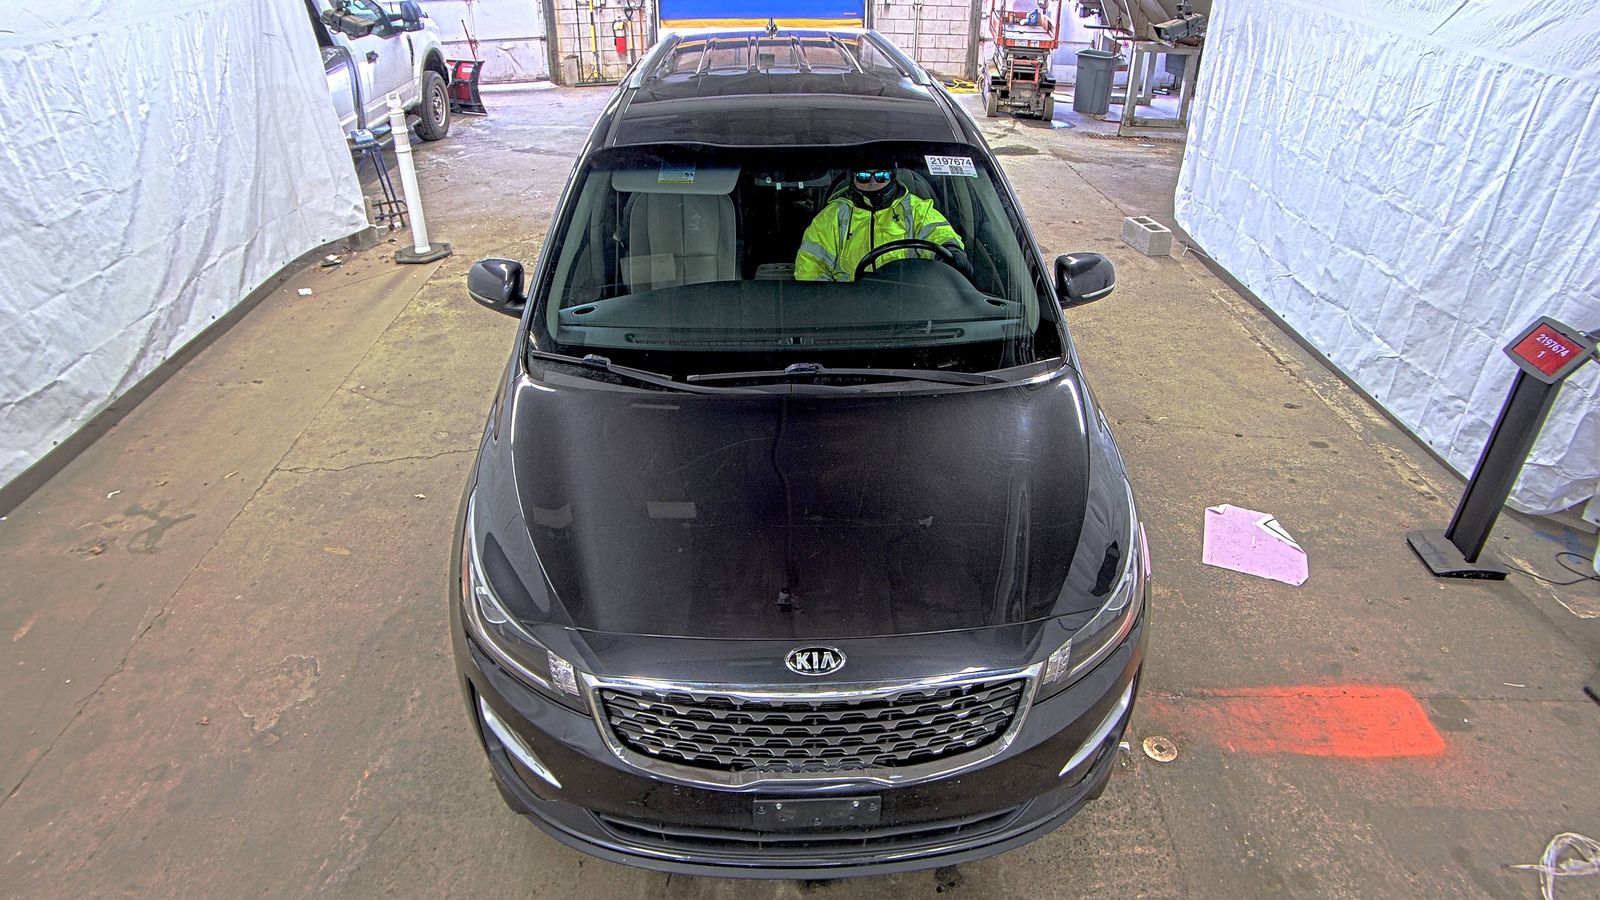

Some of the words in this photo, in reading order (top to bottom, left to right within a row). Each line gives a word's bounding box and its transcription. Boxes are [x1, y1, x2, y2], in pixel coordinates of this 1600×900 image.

[930, 157, 972, 166] 2197674
[1536, 334, 1570, 357] 2197674
[795, 651, 836, 670] KIA
